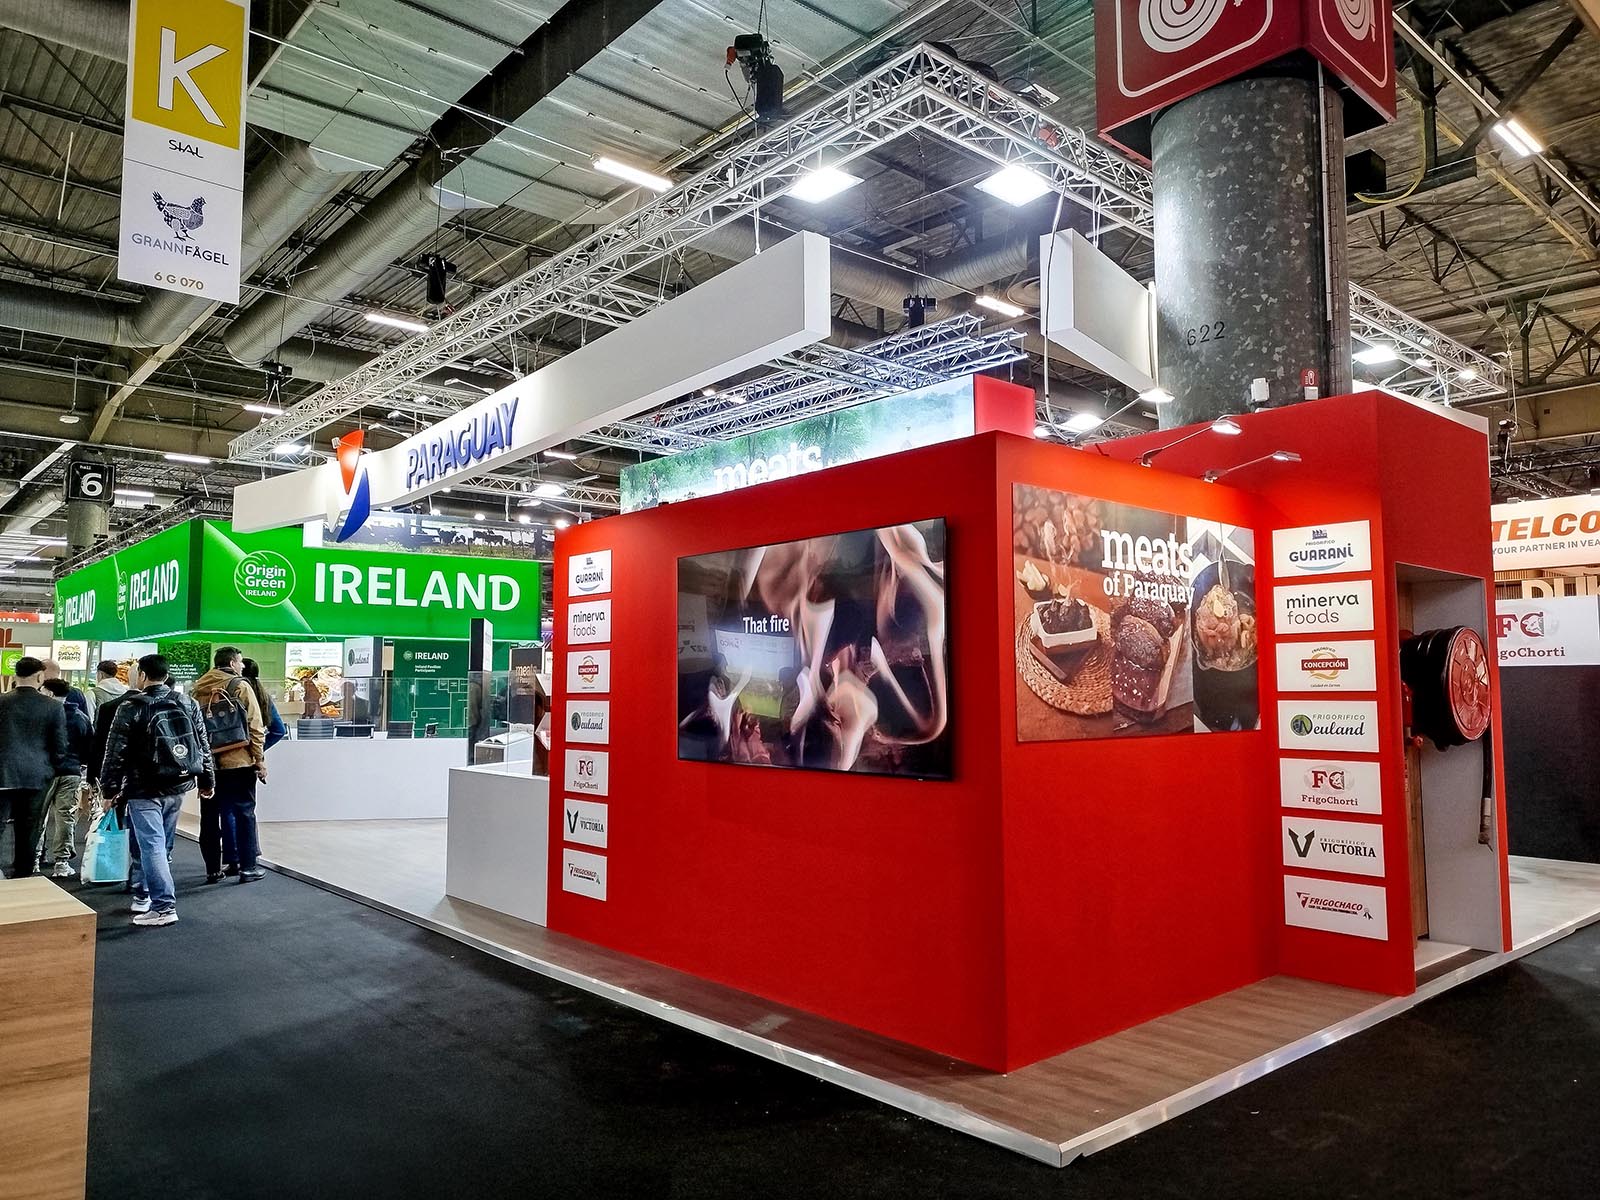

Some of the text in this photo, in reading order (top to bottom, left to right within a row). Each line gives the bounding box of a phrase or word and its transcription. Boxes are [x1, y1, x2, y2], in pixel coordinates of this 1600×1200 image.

[157, 26, 230, 129] K
[168, 139, 204, 159] SIAL
[131, 232, 230, 267] GRANNFÅGEL
[154, 271, 204, 291] 6 G 070
[1186, 321, 1225, 346] 622
[406, 397, 519, 490] PARAGUAY
[80, 472, 103, 497] 6
[1101, 529, 1194, 579] meats
[1519, 541, 1565, 553] PARTNER
[1568, 540, 1578, 548] IN
[245, 563, 287, 579] Origin
[129, 559, 180, 611] IRELAND
[245, 576, 286, 589] Green
[315, 562, 521, 612] IRELAND
[1103, 570, 1195, 610] of Paraguay
[245, 589, 277, 597] IRELAND
[64, 589, 96, 629] IRELAND
[1286, 594, 1360, 609] minerva
[572, 610, 606, 624] minerva
[742, 615, 790, 634] That fire
[1287, 609, 1340, 625] foods
[573, 624, 597, 637] foods
[414, 652, 449, 660] IRELAND
[1498, 646, 1566, 660] goChorti
[1303, 660, 1346, 669] CONCEPCIÓN
[573, 780, 599, 790] FrigoChorti
[1301, 794, 1359, 806] FrigoChorti
[580, 820, 605, 833] VICTORIA
[1320, 842, 1377, 858] VICTORIA
[1309, 897, 1363, 911] FRIGOCHACO
